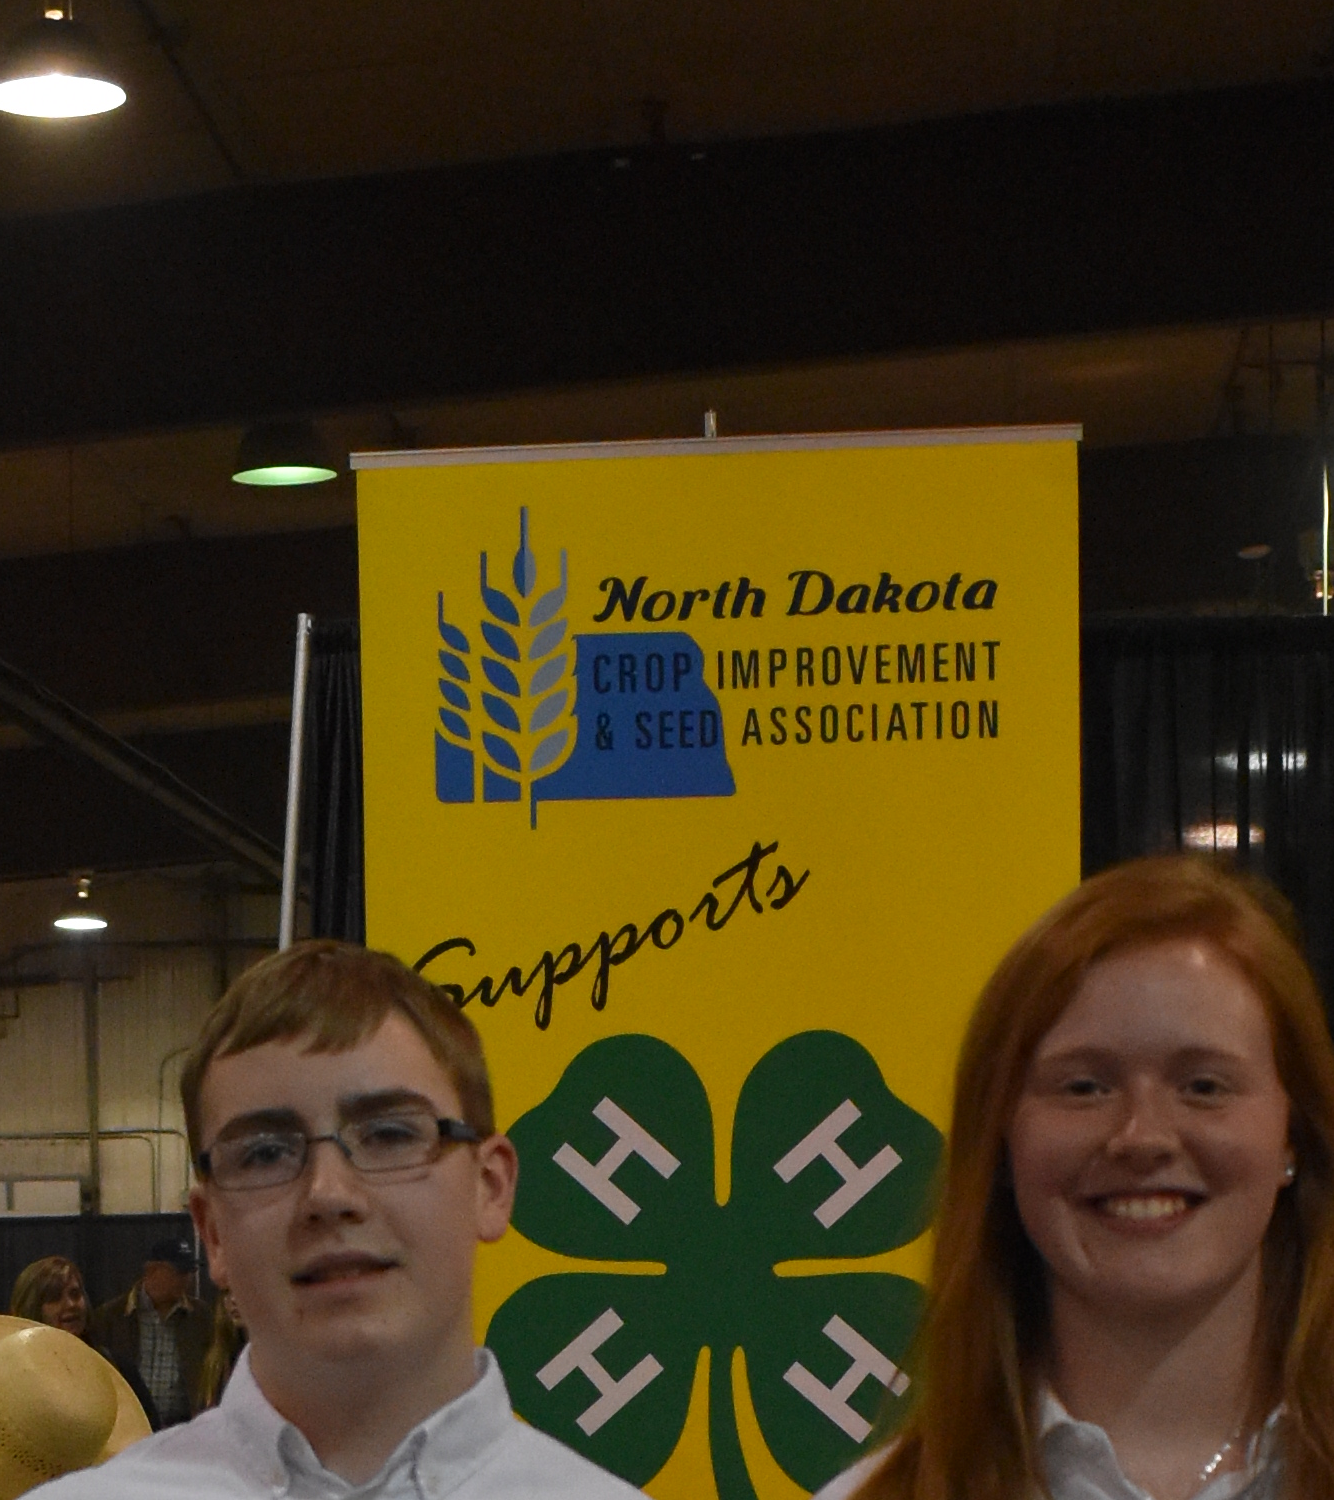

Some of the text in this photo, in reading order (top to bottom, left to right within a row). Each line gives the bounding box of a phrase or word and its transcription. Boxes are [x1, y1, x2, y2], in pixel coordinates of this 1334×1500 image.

[593, 571, 998, 624] North Dakota
[593, 641, 1001, 694] CROP IMPROVEMENT
[595, 701, 999, 751] & SEED ASSOCIATION
[552, 1095, 682, 1226] H
[772, 1098, 903, 1229] H
[535, 1306, 664, 1437] H
[782, 1314, 912, 1444] H
